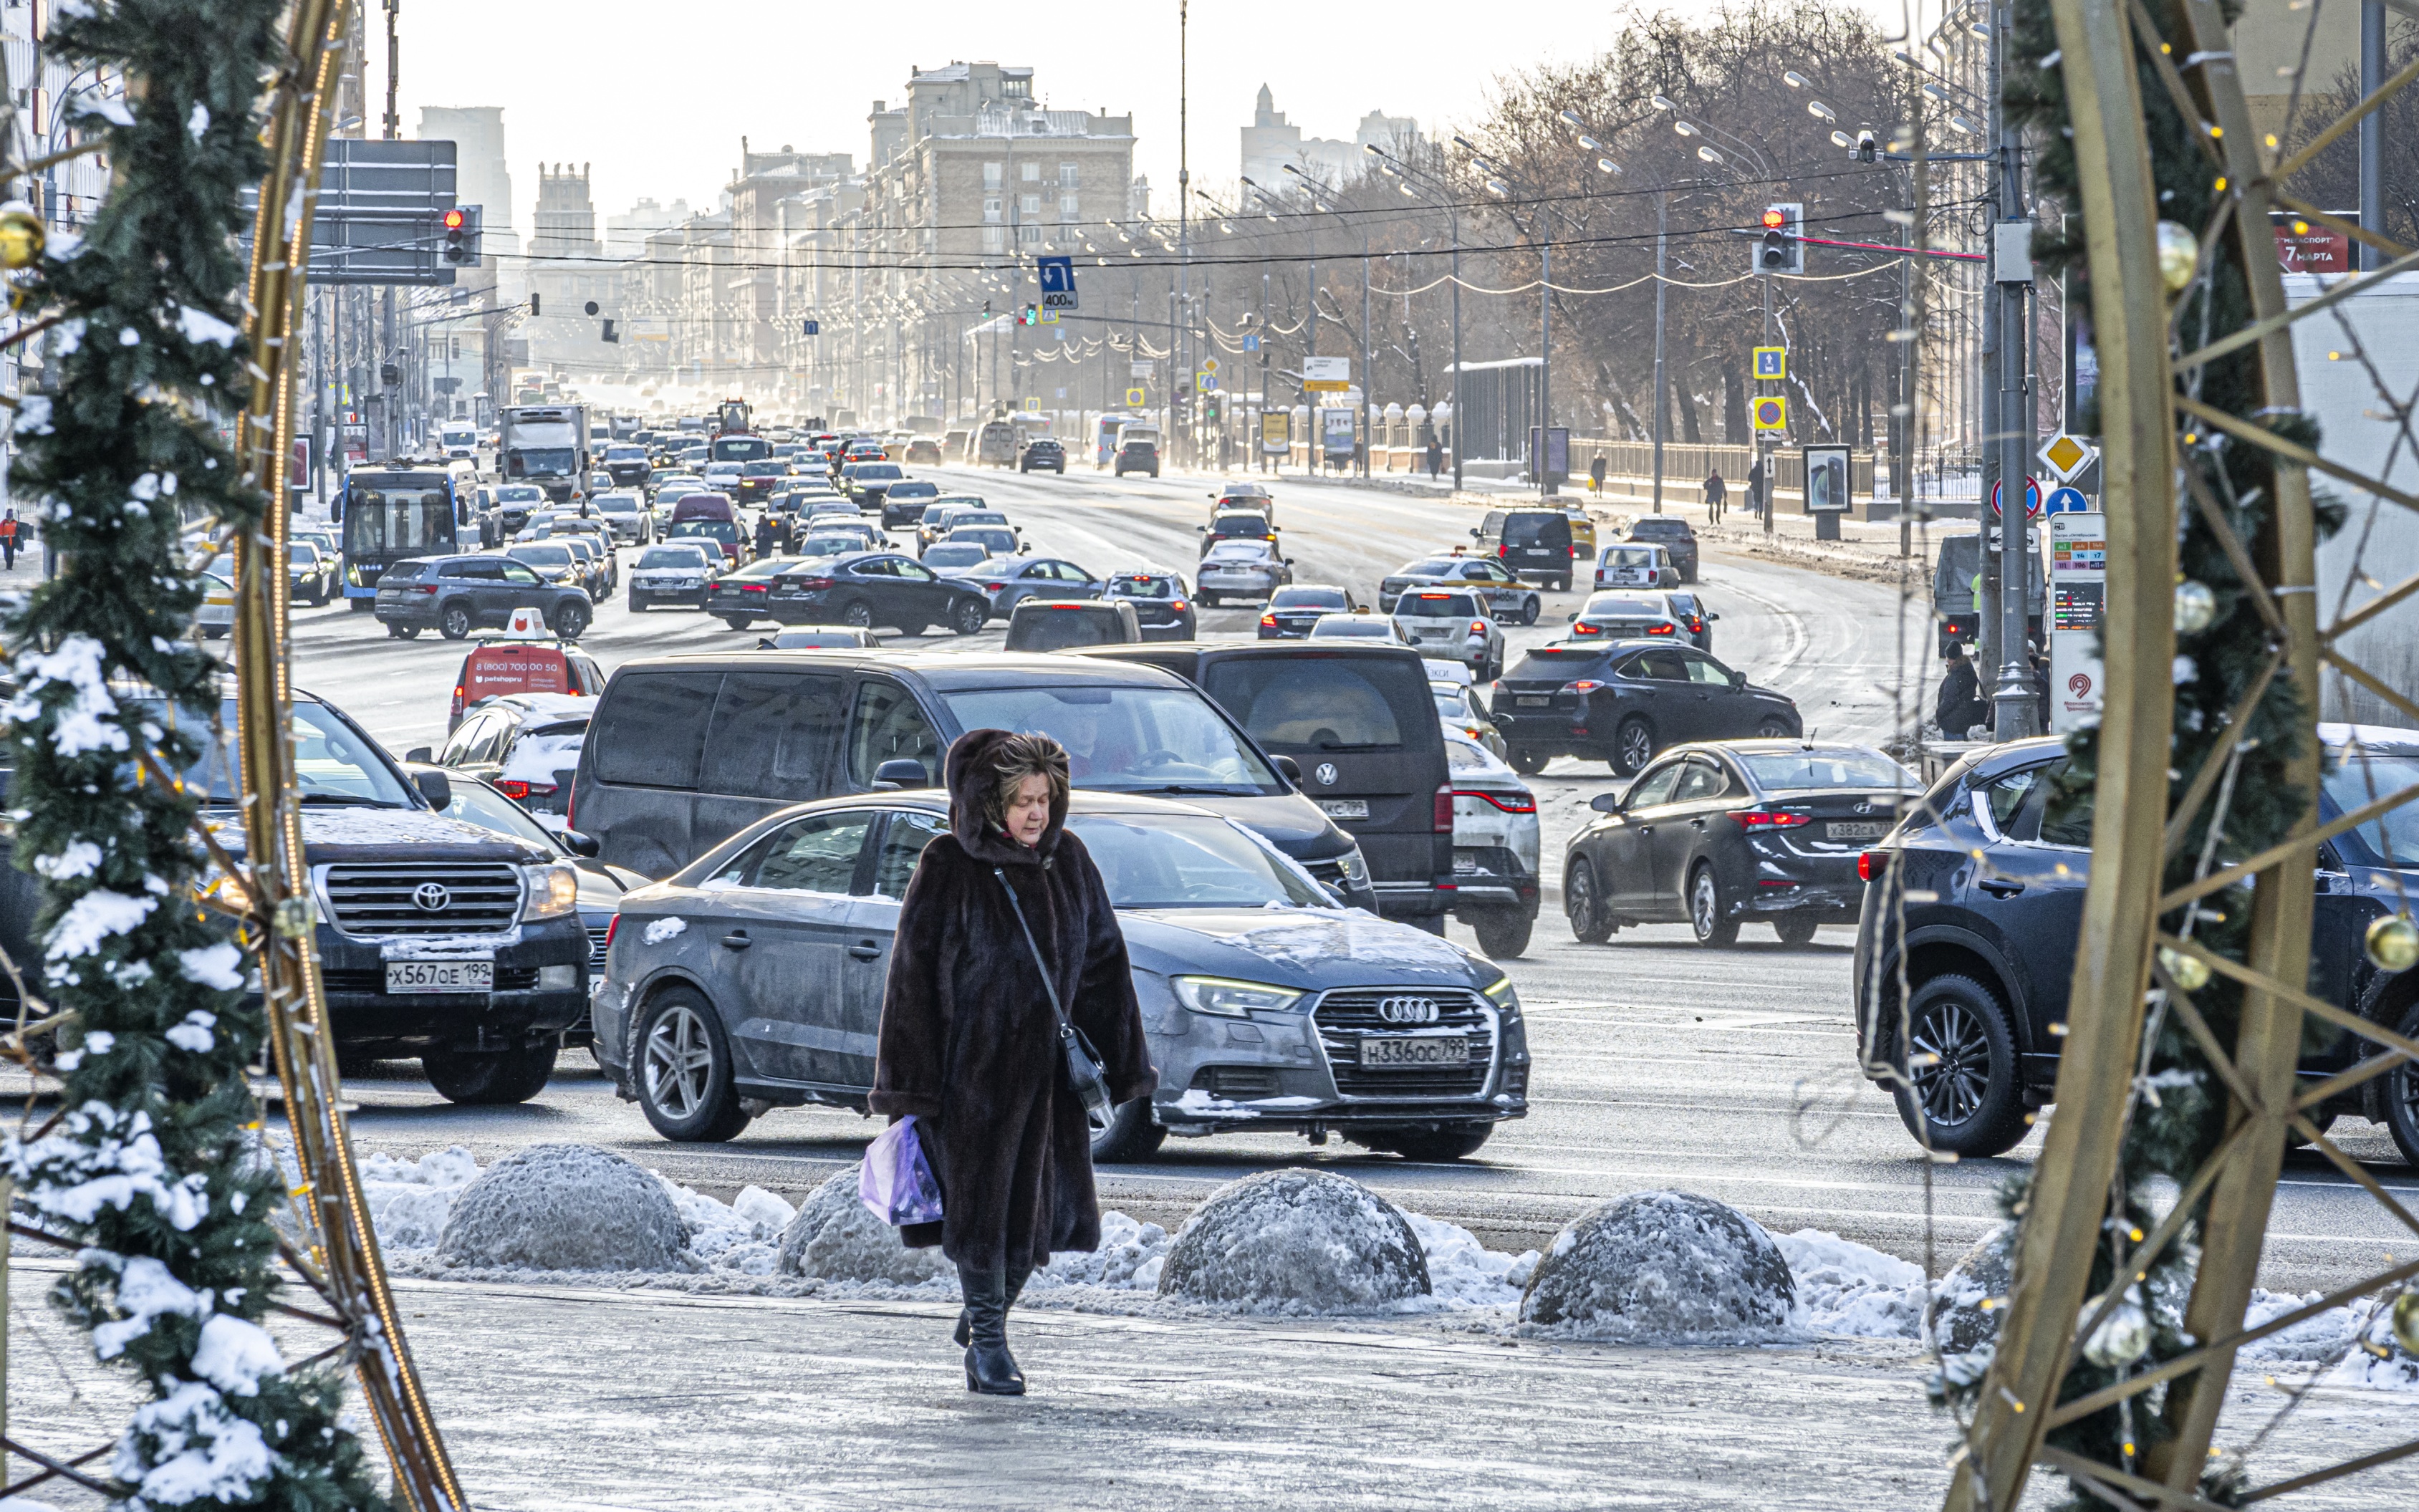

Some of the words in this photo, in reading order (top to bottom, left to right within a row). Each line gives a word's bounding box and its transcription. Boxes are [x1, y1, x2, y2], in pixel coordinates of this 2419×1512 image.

[2285, 246, 2297, 261] 7
[2297, 252, 2333, 261] МАРТА
[484, 663, 507, 672] (800)
[544, 663, 557, 672] 50
[1425, 665, 1449, 678] Такси
[464, 963, 489, 978] 199
